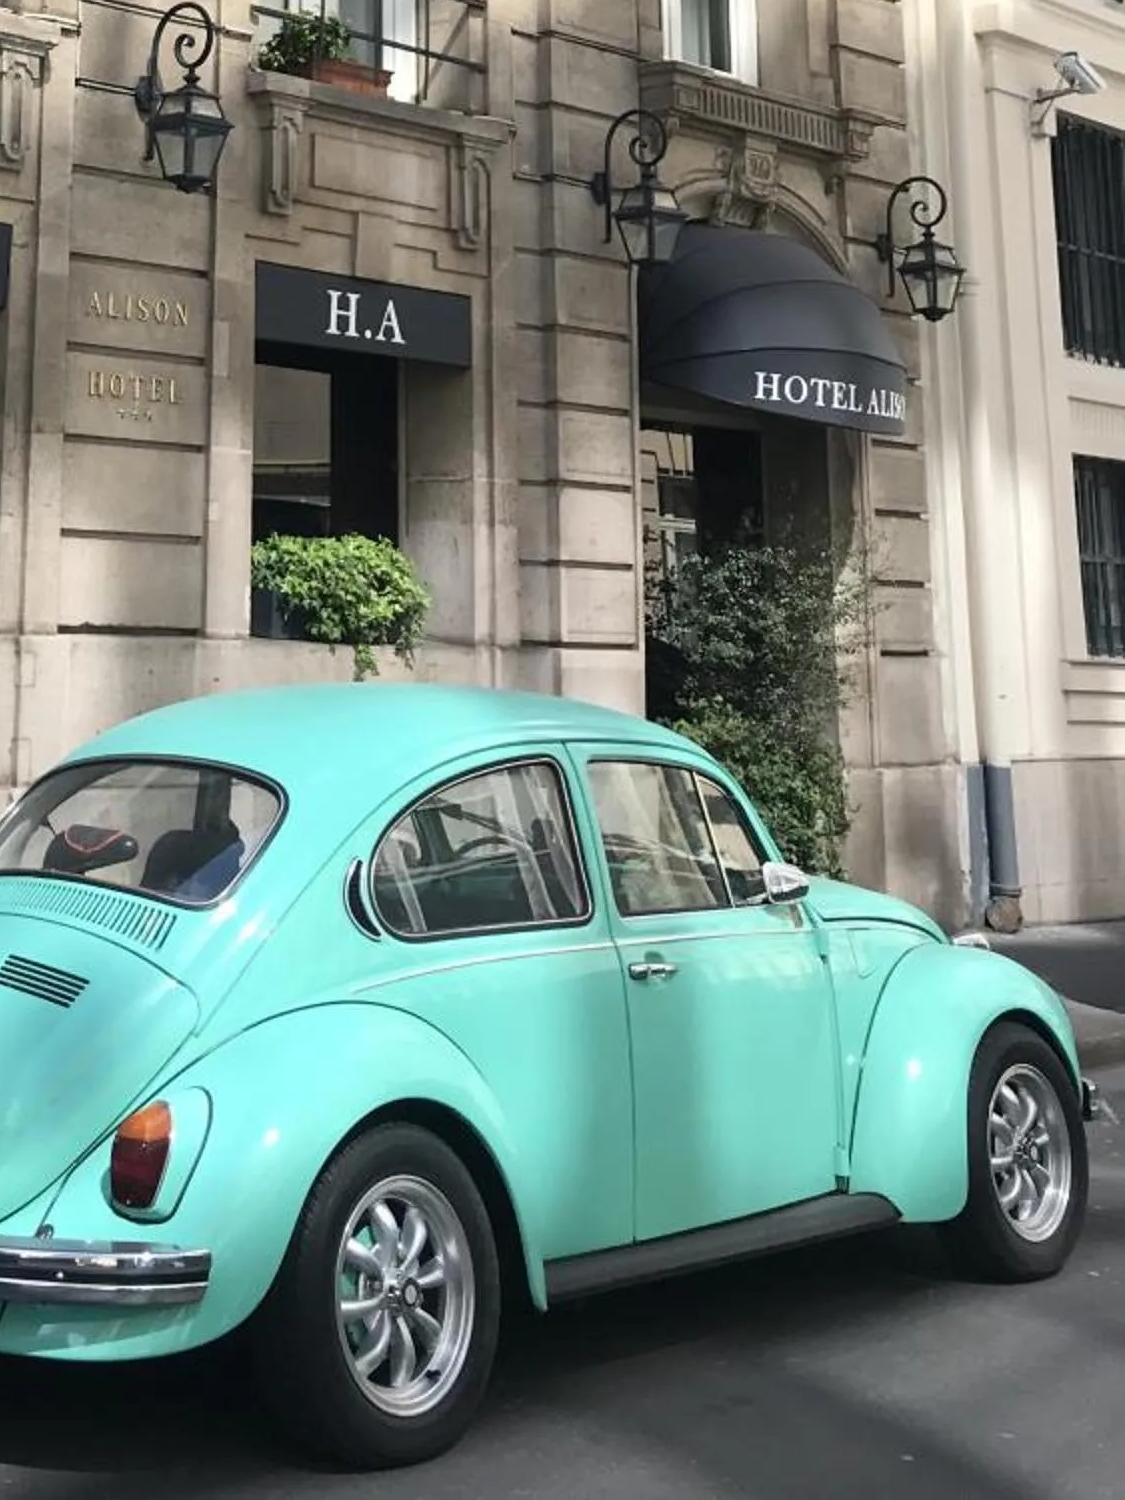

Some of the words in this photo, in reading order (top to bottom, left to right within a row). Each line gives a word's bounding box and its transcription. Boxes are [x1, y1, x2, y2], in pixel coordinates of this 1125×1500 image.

[86, 291, 188, 327] ALISON
[326, 289, 406, 345] H.A
[88, 371, 183, 405] HOTEL
[754, 371, 863, 413] HOTEL
